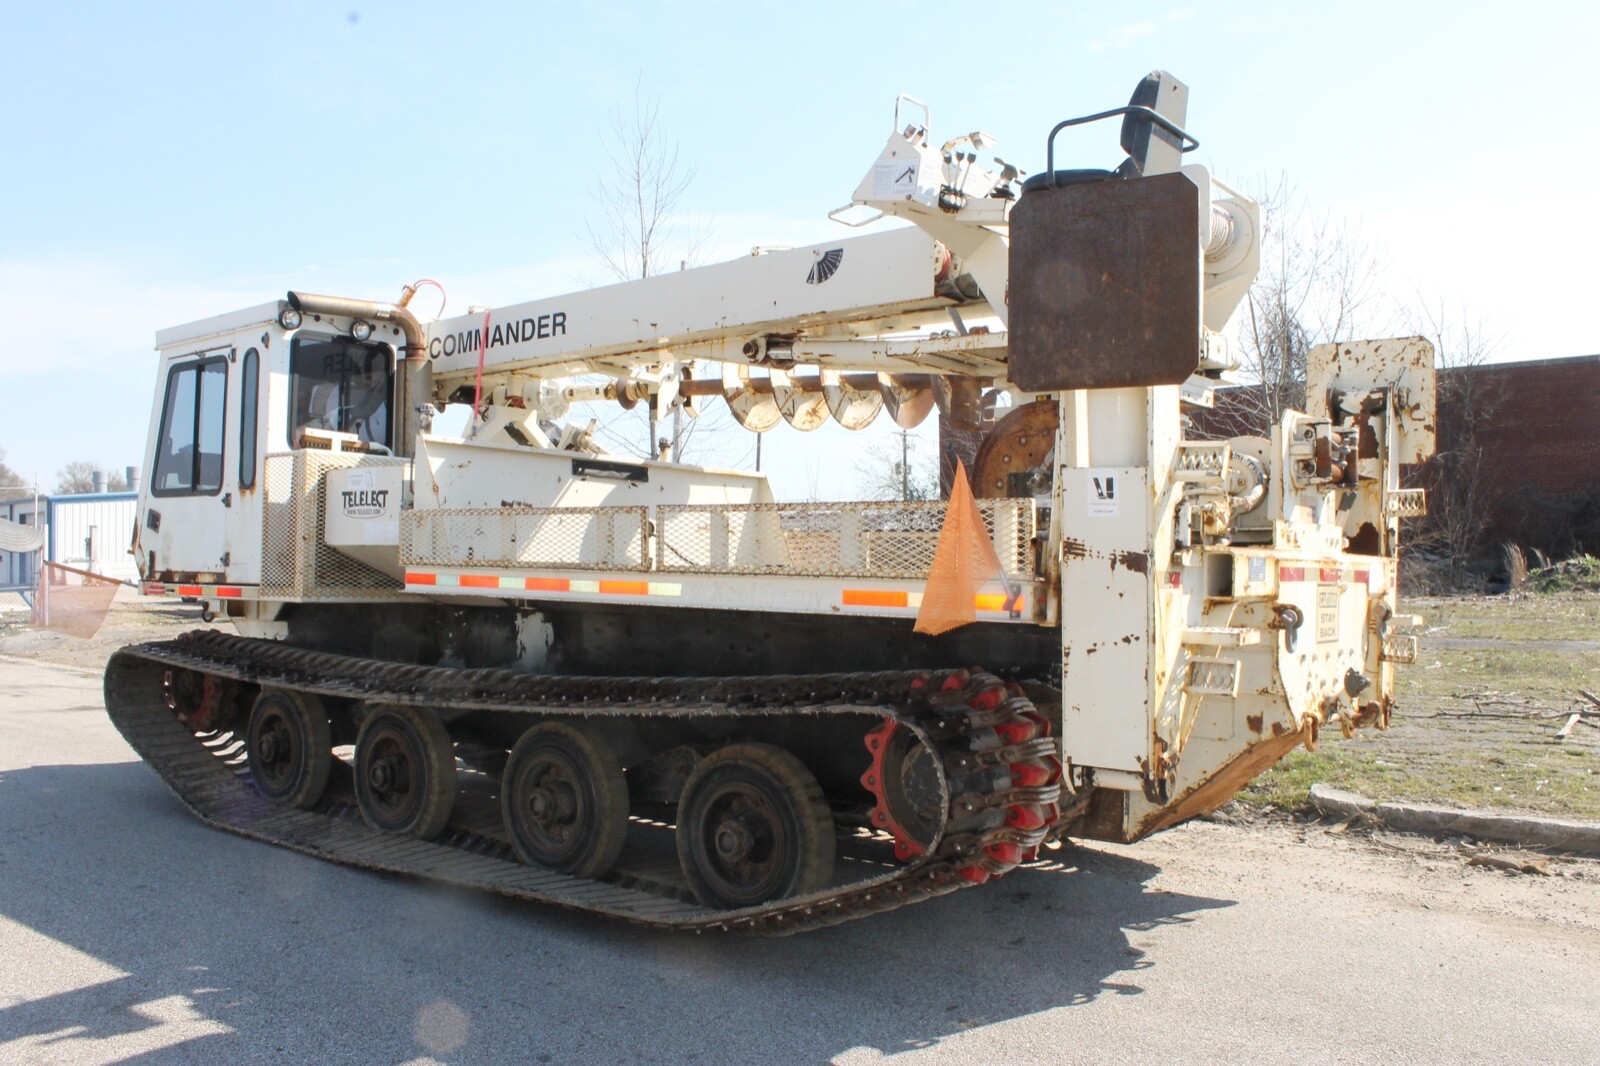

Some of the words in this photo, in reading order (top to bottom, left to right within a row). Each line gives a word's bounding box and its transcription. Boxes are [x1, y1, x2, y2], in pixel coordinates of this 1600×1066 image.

[429, 311, 567, 360] COMMANDER
[341, 490, 389, 508] TELELECT
[1320, 613, 1336, 623] STAY
[1319, 627, 1336, 638] BACK
